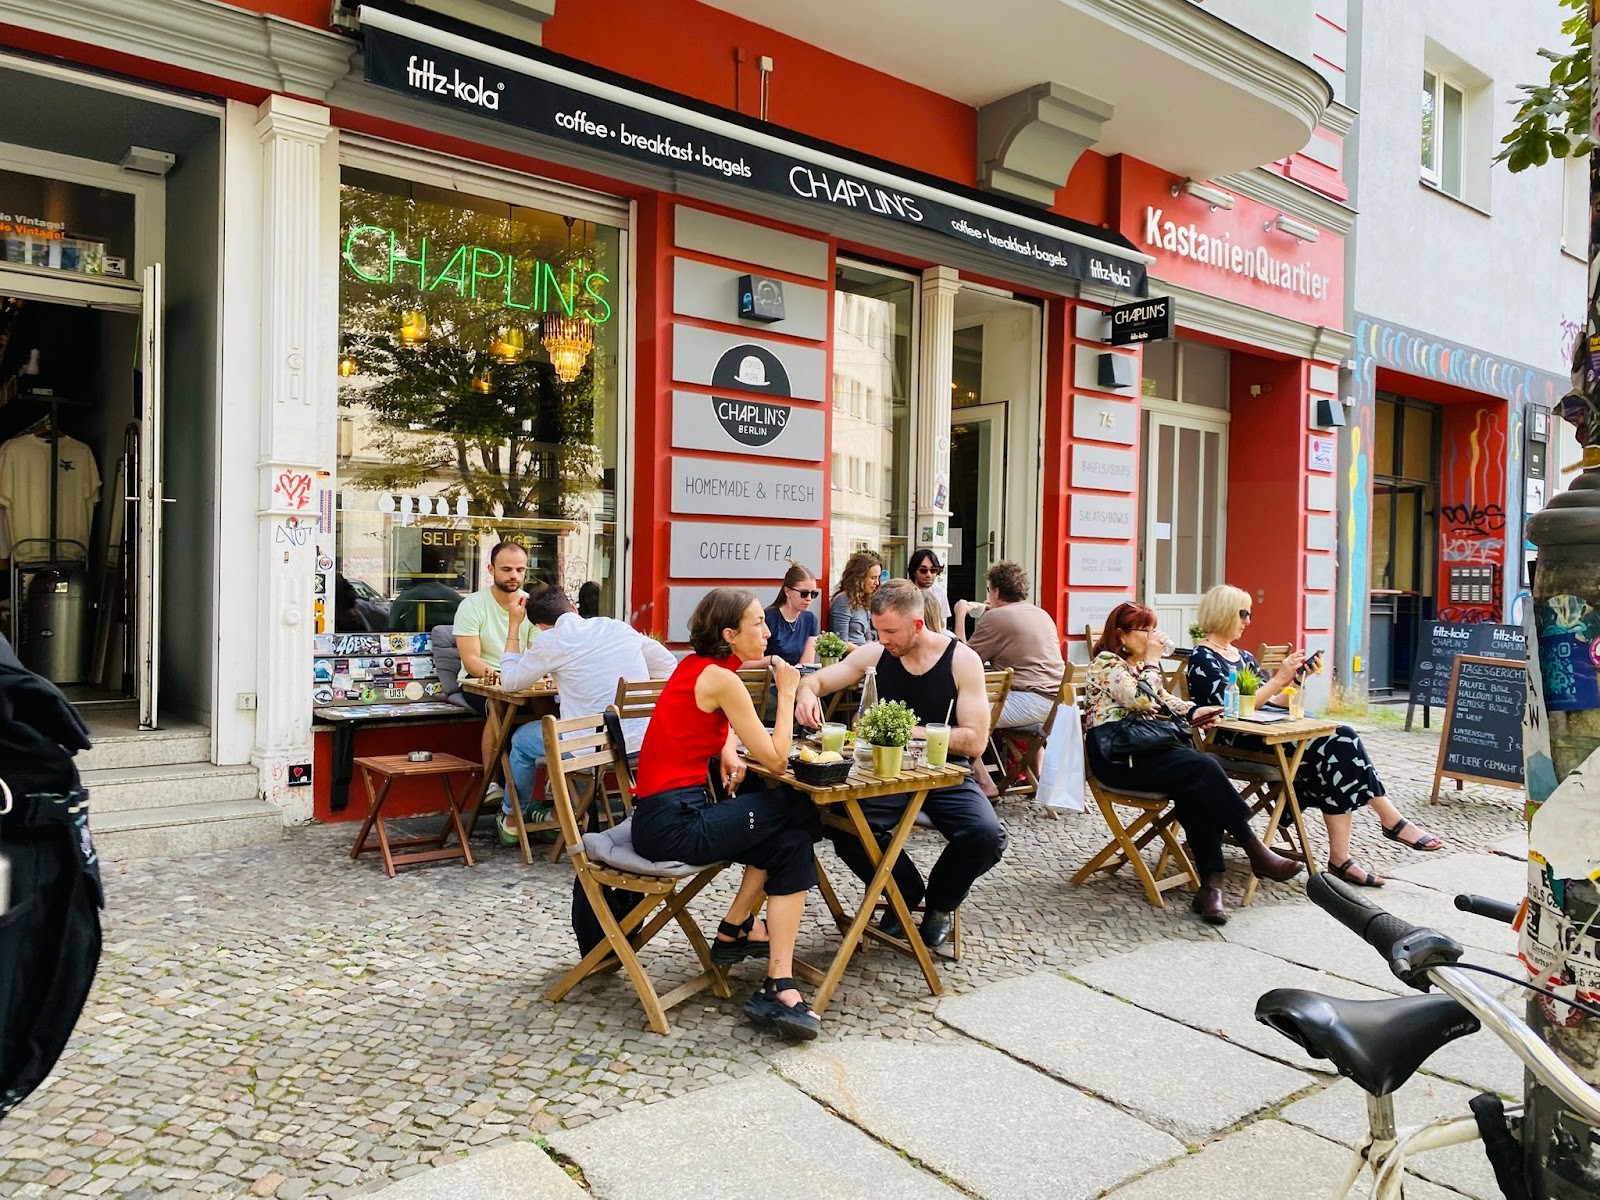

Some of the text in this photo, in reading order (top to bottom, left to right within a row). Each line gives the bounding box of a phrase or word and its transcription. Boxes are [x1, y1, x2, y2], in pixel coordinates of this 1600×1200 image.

[555, 110, 752, 177] coffee breakfast bagels
[789, 165, 924, 222] CHAPLIN'S
[14, 214, 65, 230] Vintage!
[15, 225, 65, 240] Vintage!
[951, 220, 1068, 267] coffee breakfast bagels
[1146, 206, 1329, 300] KastanienQuartier
[346, 224, 611, 324] CHAPLIN'S
[1115, 303, 1166, 325] CHAPLIN'S
[718, 402, 786, 427] CHAPLIN'S
[738, 424, 768, 436] BERLIN
[685, 476, 815, 502] HOMEMADE & FRESH
[422, 531, 463, 547] SELF
[700, 541, 751, 561] COFFEE
[766, 544, 793, 562] TEA
[1458, 689, 1493, 701] HALLOUMI
[1459, 679, 1488, 691] FALAFEL
[1448, 753, 1461, 764] MIT
[1483, 759, 1518, 774] GEMACHT
